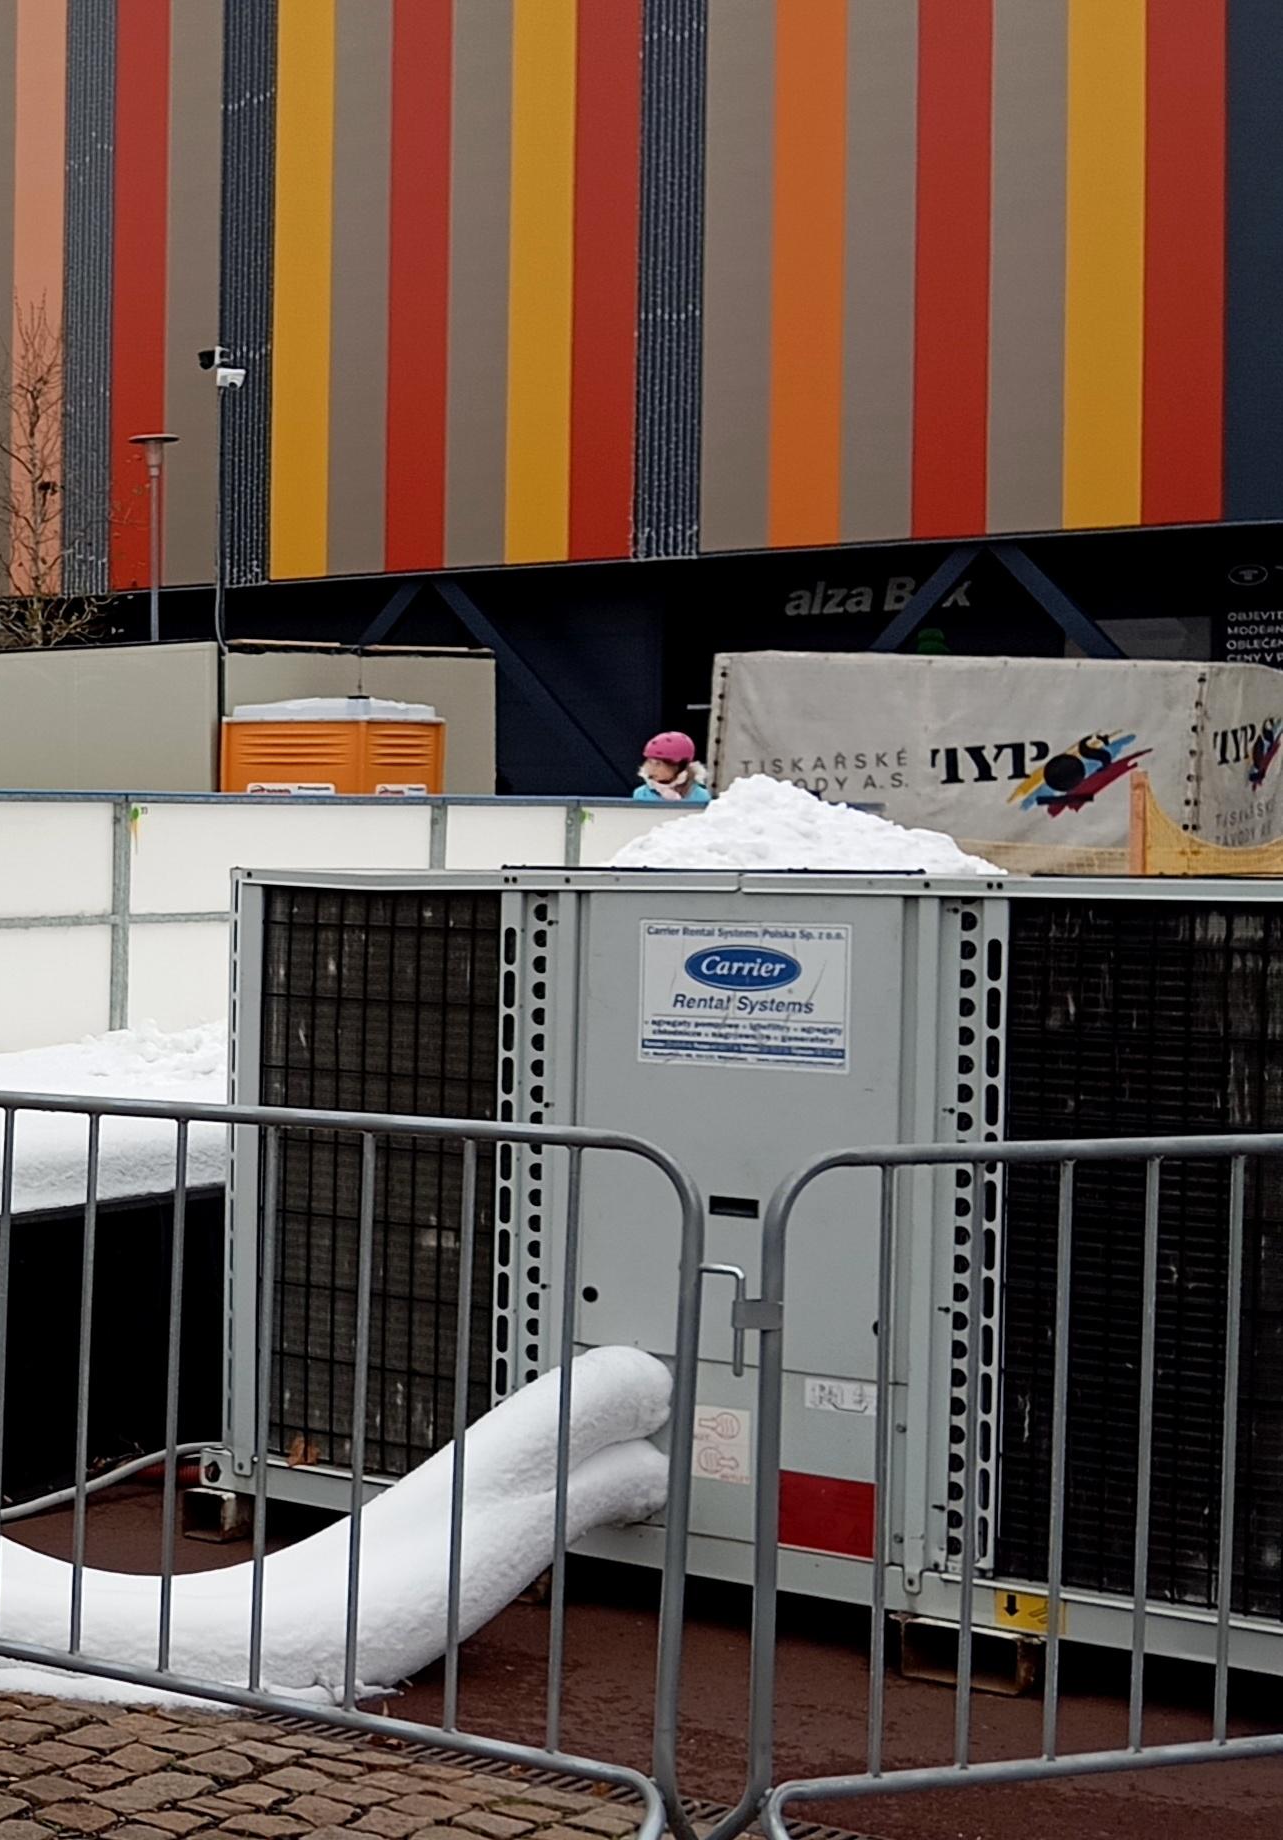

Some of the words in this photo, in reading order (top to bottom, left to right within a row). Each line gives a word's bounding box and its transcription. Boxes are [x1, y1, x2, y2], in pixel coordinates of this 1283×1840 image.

[785, 581, 874, 616] alza
[883, 576, 972, 612] Bx
[740, 748, 909, 775] TISKAŘSKÉ
[647, 925, 680, 936] Carrier
[683, 926, 715, 937] Rental
[717, 928, 759, 940] Systems
[763, 929, 796, 940] Polska
[798, 930, 815, 942] Sp.
[700, 955, 786, 978] Carrier
[673, 993, 731, 1011] Rental
[736, 995, 815, 1015] Systems
